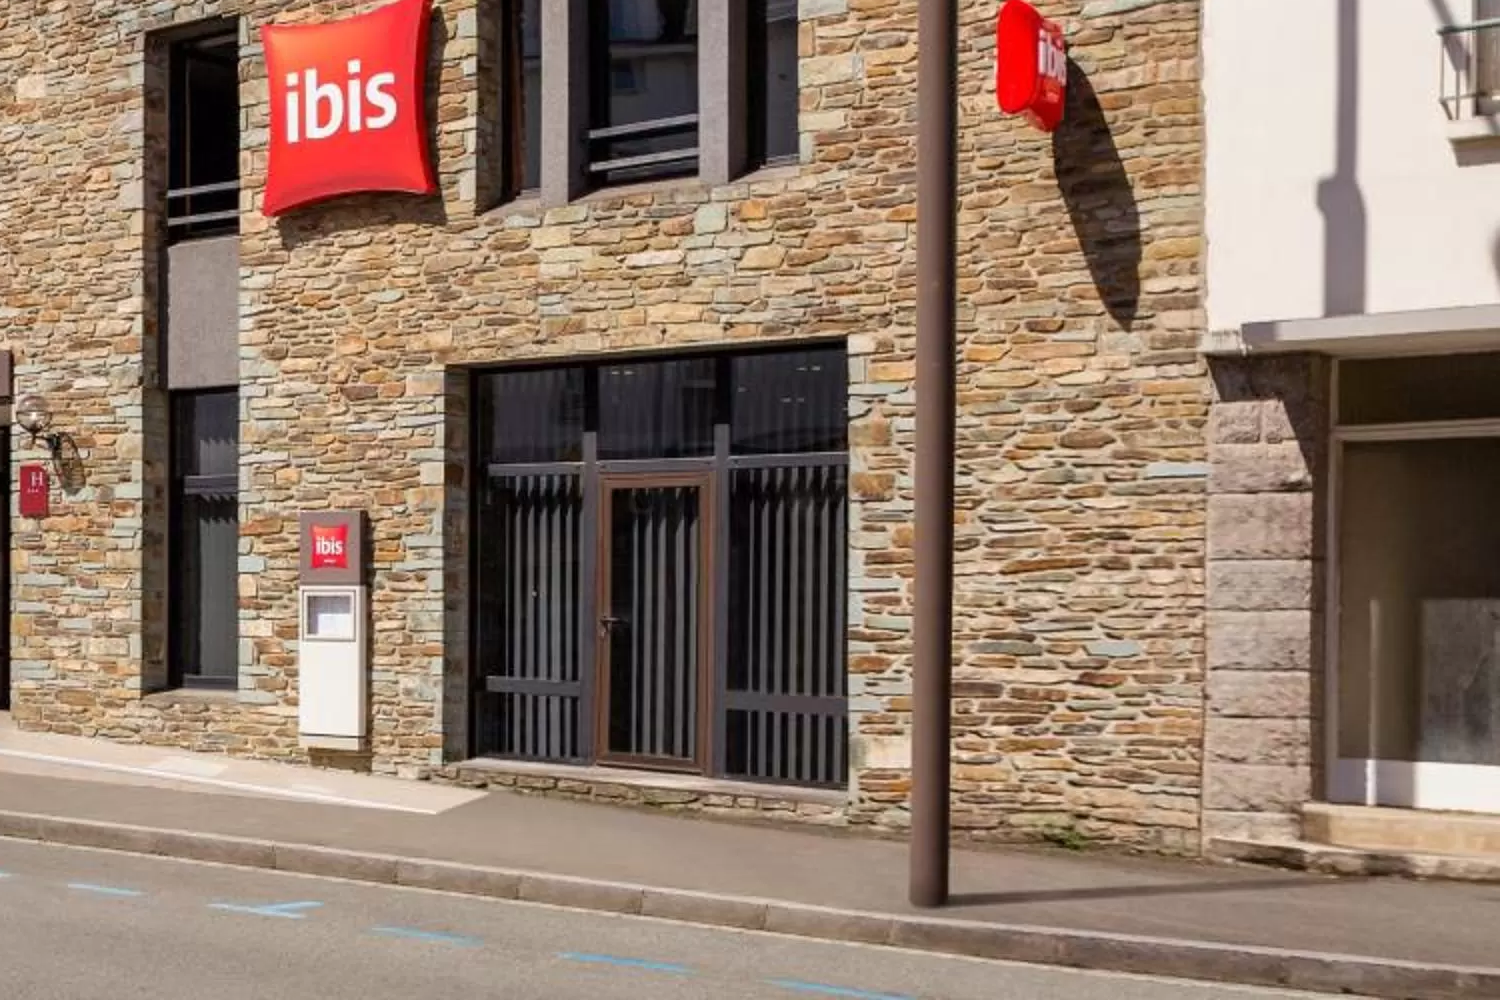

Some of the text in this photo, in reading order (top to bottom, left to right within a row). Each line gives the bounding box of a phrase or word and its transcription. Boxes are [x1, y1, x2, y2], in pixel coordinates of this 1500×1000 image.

[286, 59, 397, 143] ibis
[31, 471, 43, 486] H
[315, 536, 344, 555] ibis
